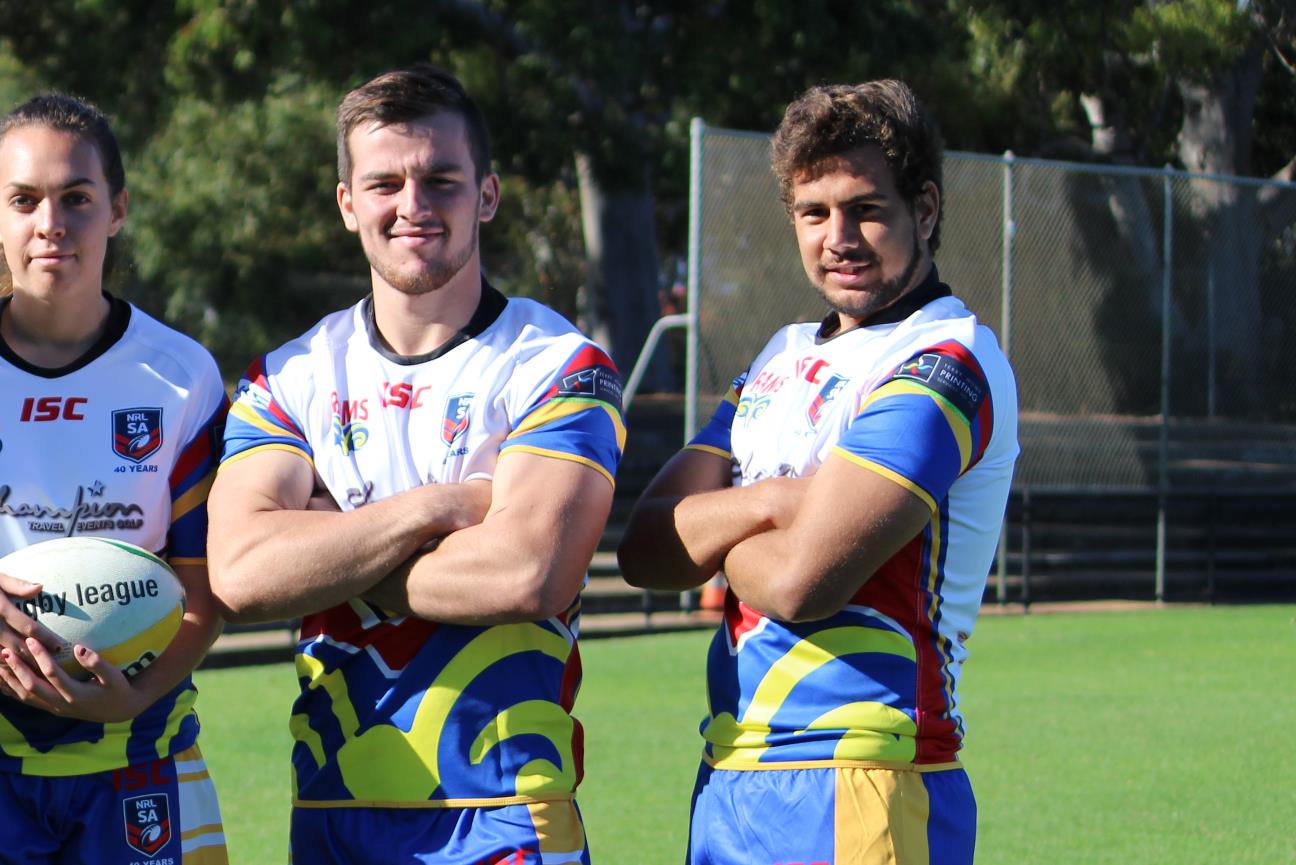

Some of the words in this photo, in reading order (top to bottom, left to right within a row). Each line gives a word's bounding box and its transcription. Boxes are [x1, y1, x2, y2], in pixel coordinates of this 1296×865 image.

[940, 369, 978, 402] PRINTING
[20, 397, 88, 422] ISC
[127, 414, 148, 422] NRL
[128, 422, 148, 434] SA
[130, 465, 158, 473] YEARS
[29, 521, 65, 532] TRAVEL
[77, 520, 114, 532] EVENTS
[117, 519, 144, 530] GOLF
[76, 579, 159, 606] league
[136, 799, 157, 809] NRL
[138, 810, 159, 823] SA
